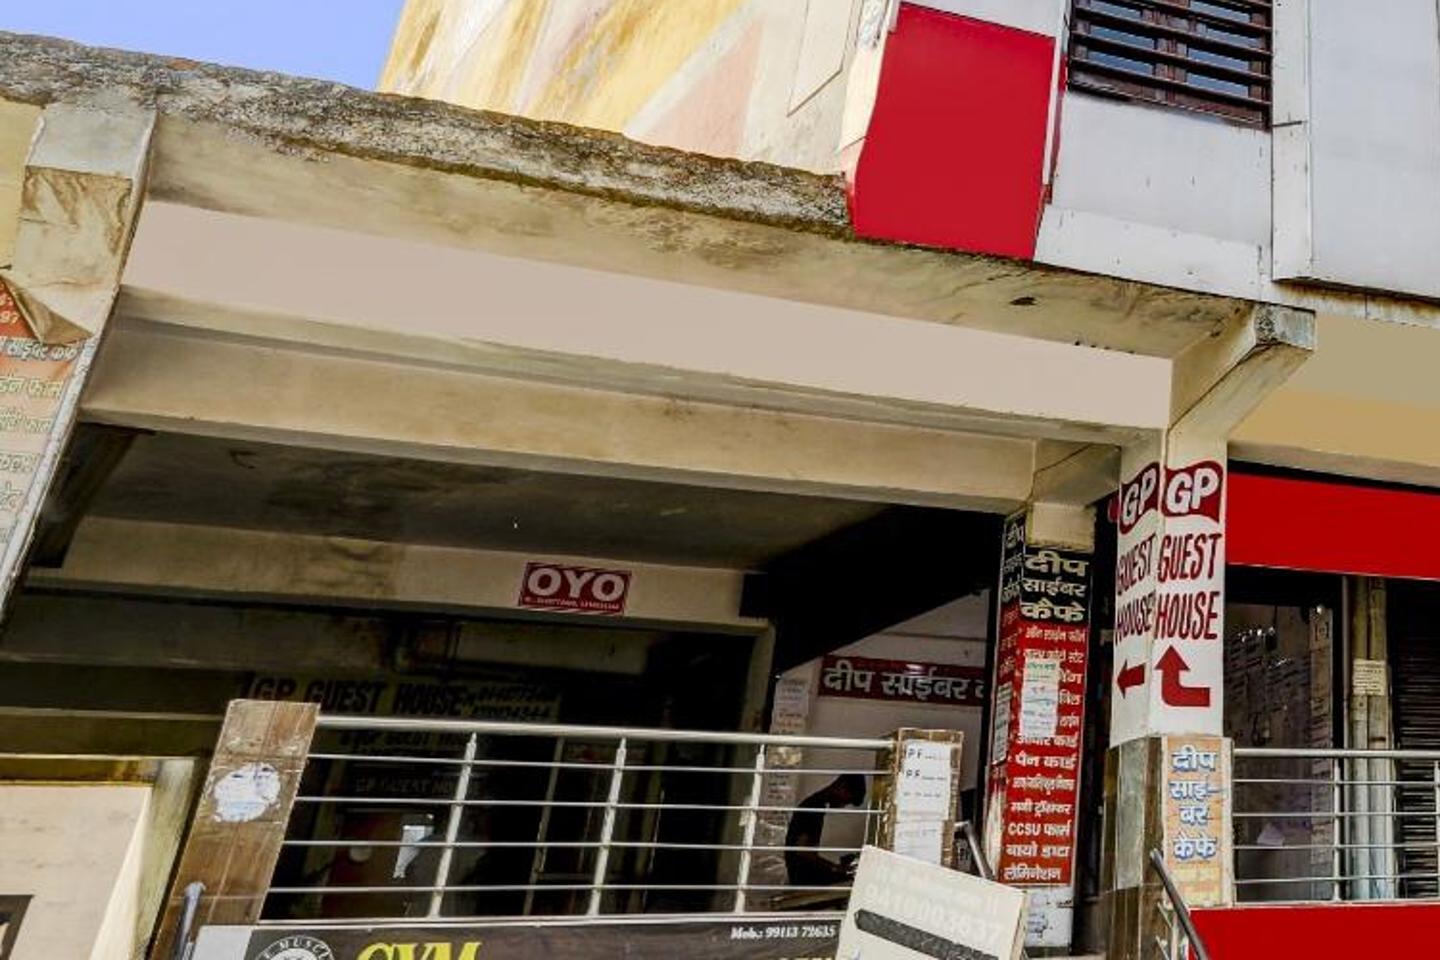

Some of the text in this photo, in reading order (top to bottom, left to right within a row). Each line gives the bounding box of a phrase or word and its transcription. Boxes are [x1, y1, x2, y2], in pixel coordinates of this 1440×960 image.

[1123, 468, 1157, 525] GP
[1166, 467, 1219, 514] GP
[1024, 551, 1089, 577] दीप
[1157, 534, 1222, 583] GUEST
[527, 567, 625, 602] OYO
[1154, 591, 1220, 640] HOUSE
[823, 659, 875, 692] दीप
[1008, 822, 1041, 836] CCSU
